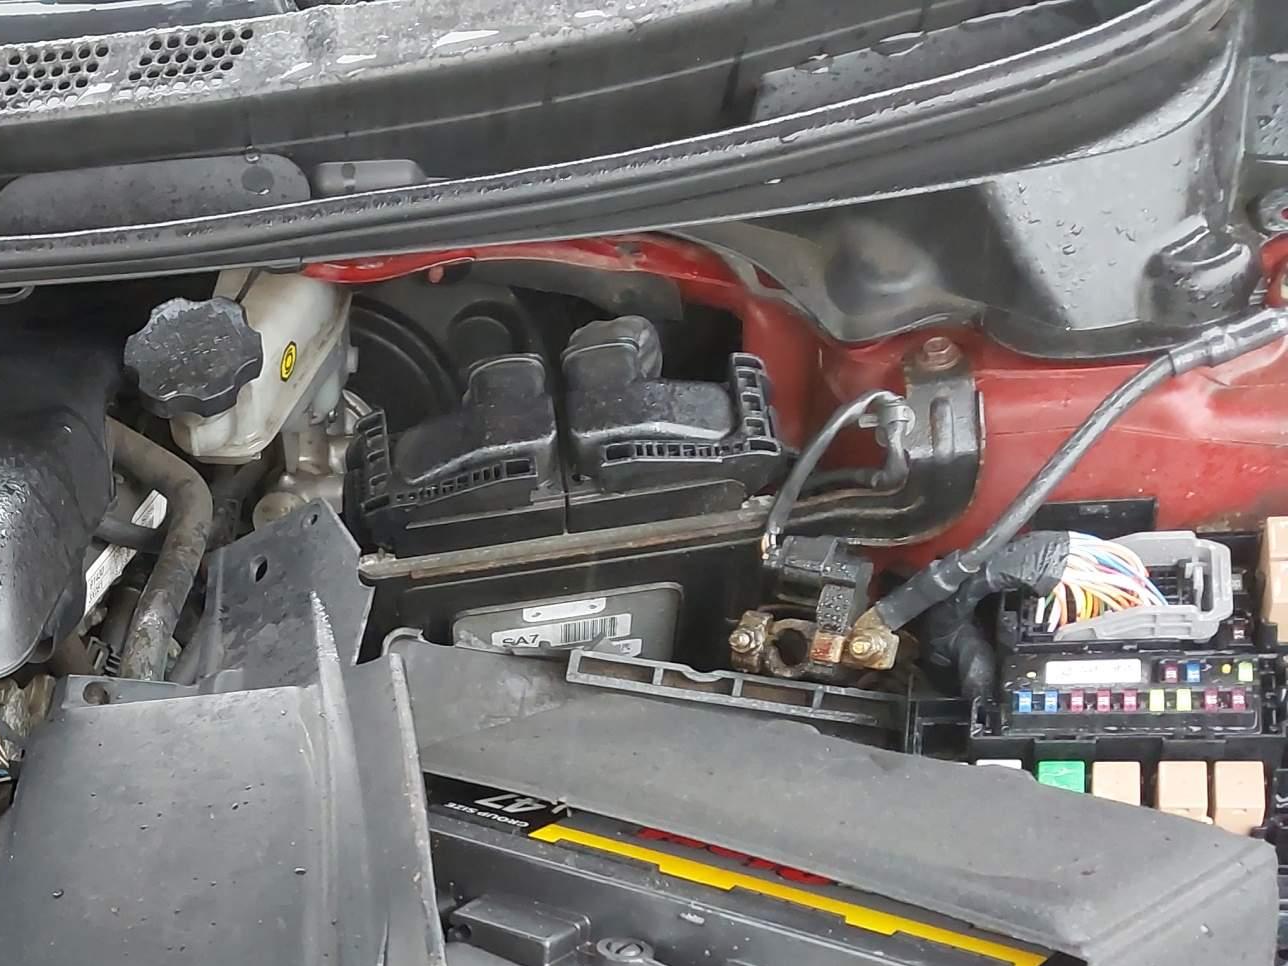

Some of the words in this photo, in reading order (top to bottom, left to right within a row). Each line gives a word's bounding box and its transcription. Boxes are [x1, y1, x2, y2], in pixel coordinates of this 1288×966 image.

[443, 801, 478, 815] SIZE
[473, 793, 547, 814] 47
[477, 810, 530, 828] GROUP
